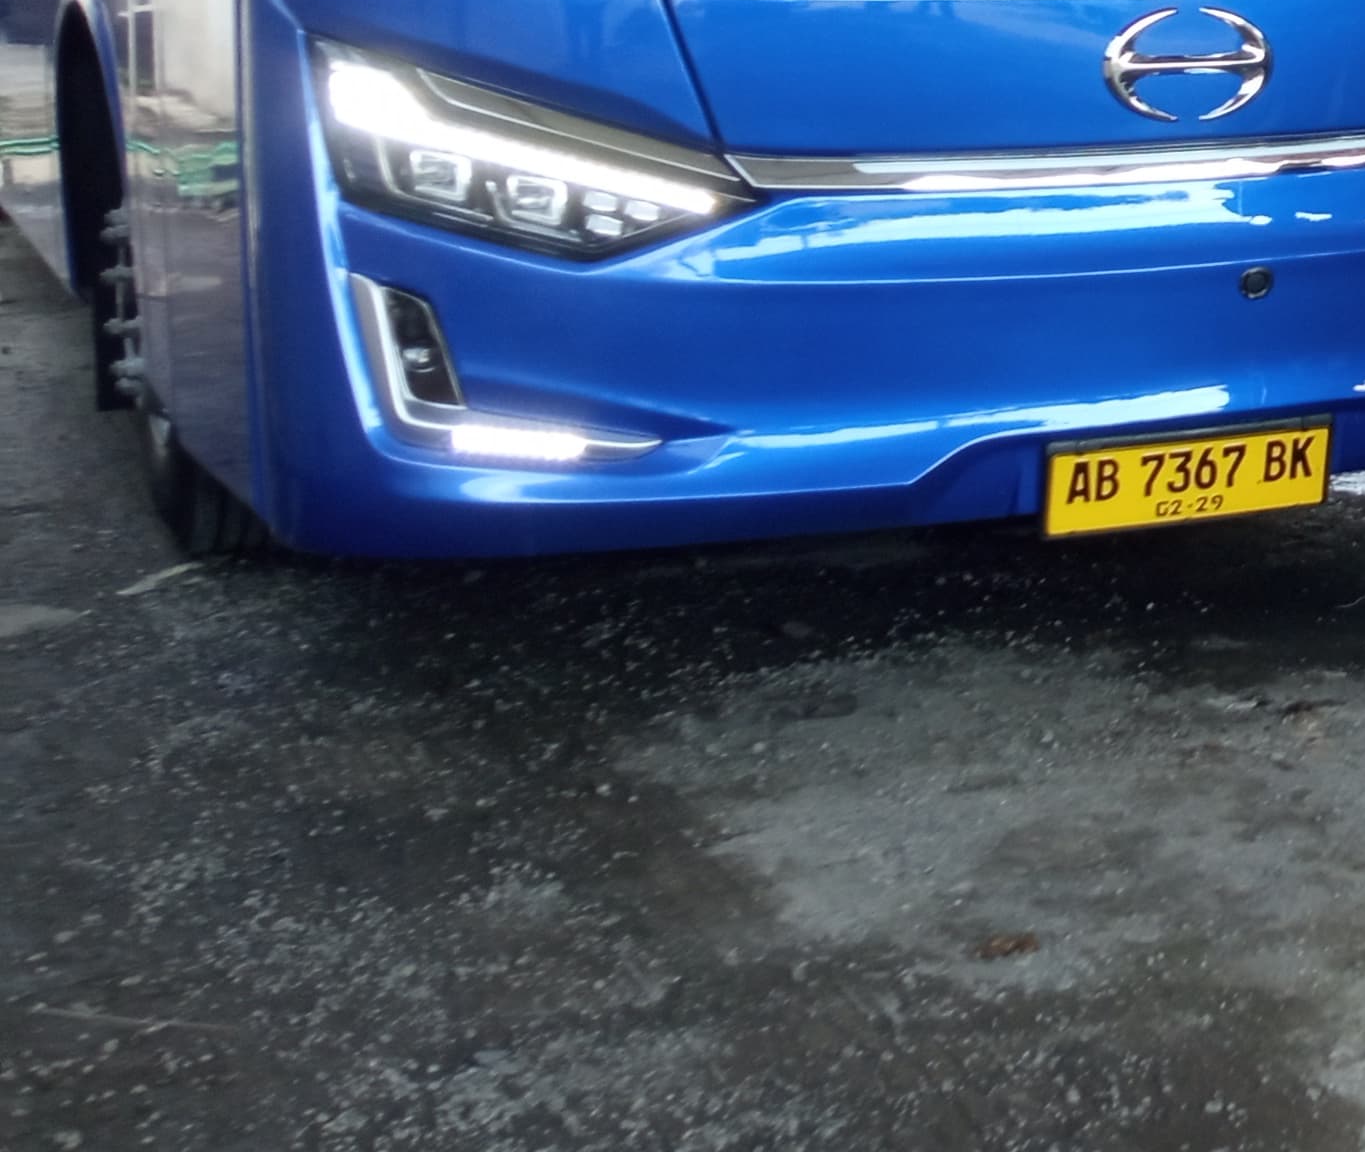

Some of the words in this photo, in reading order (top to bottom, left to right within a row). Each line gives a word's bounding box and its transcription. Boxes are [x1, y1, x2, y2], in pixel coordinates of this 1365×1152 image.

[1064, 458, 1121, 504] AB
[1140, 443, 1248, 498] 7367
[1262, 434, 1317, 484] BK
